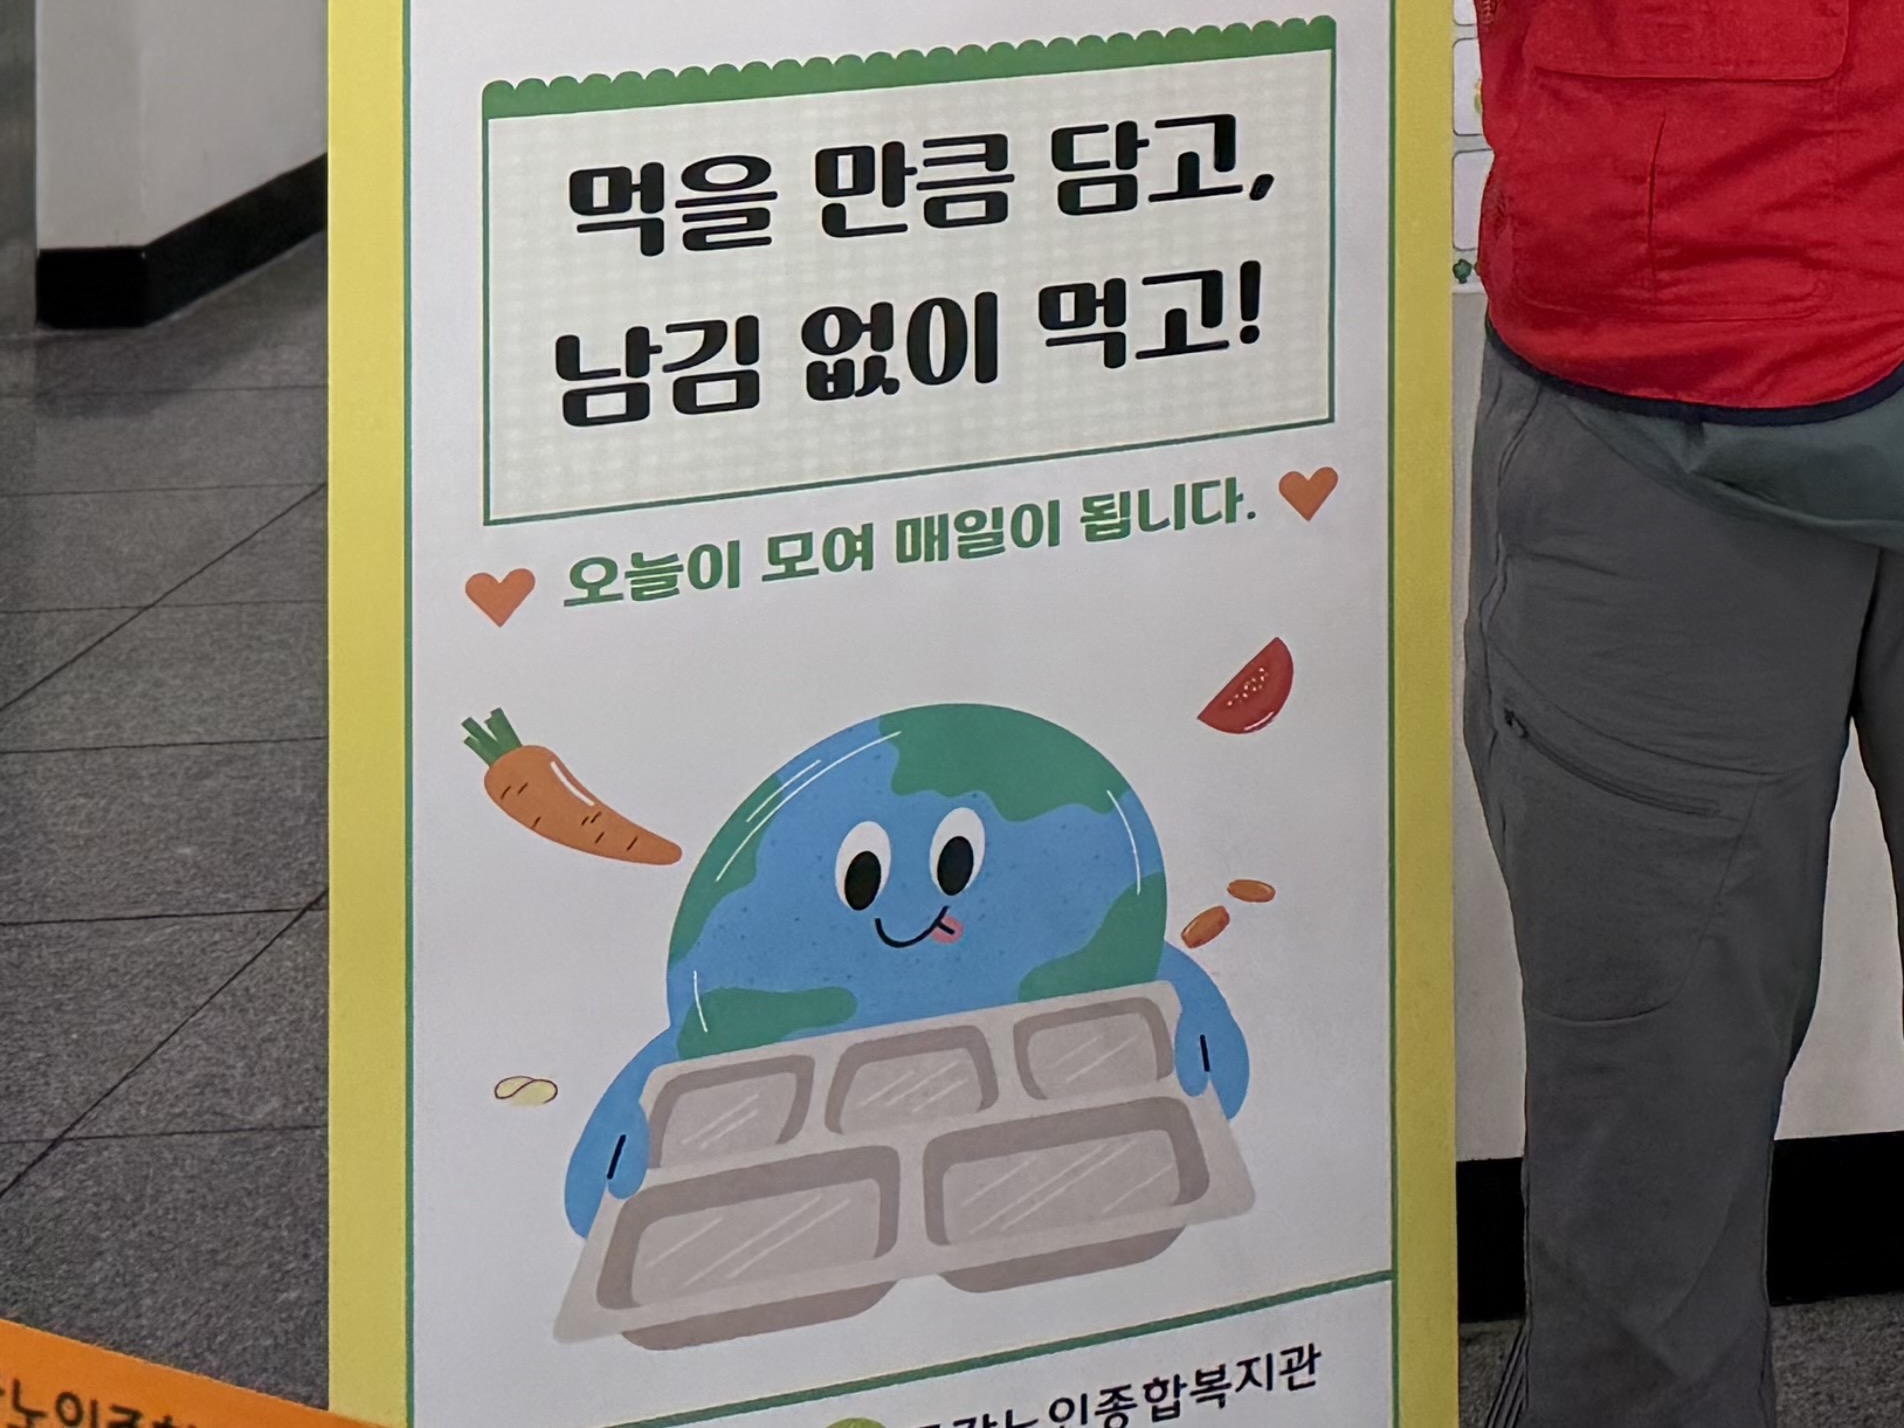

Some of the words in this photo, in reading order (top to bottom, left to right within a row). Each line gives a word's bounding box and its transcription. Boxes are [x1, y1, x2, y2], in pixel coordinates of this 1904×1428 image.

[567, 154, 778, 258] 먹을
[814, 133, 1017, 241] 만큼
[1049, 112, 1277, 218] 담고,
[554, 314, 763, 430] 남김
[799, 290, 1000, 403] 없이
[1037, 259, 1264, 370] 먹고!
[563, 539, 741, 610] 오늘이
[761, 521, 875, 587] 모여
[895, 499, 1061, 568] 매일이
[1080, 476, 1258, 545] 됩니다.
